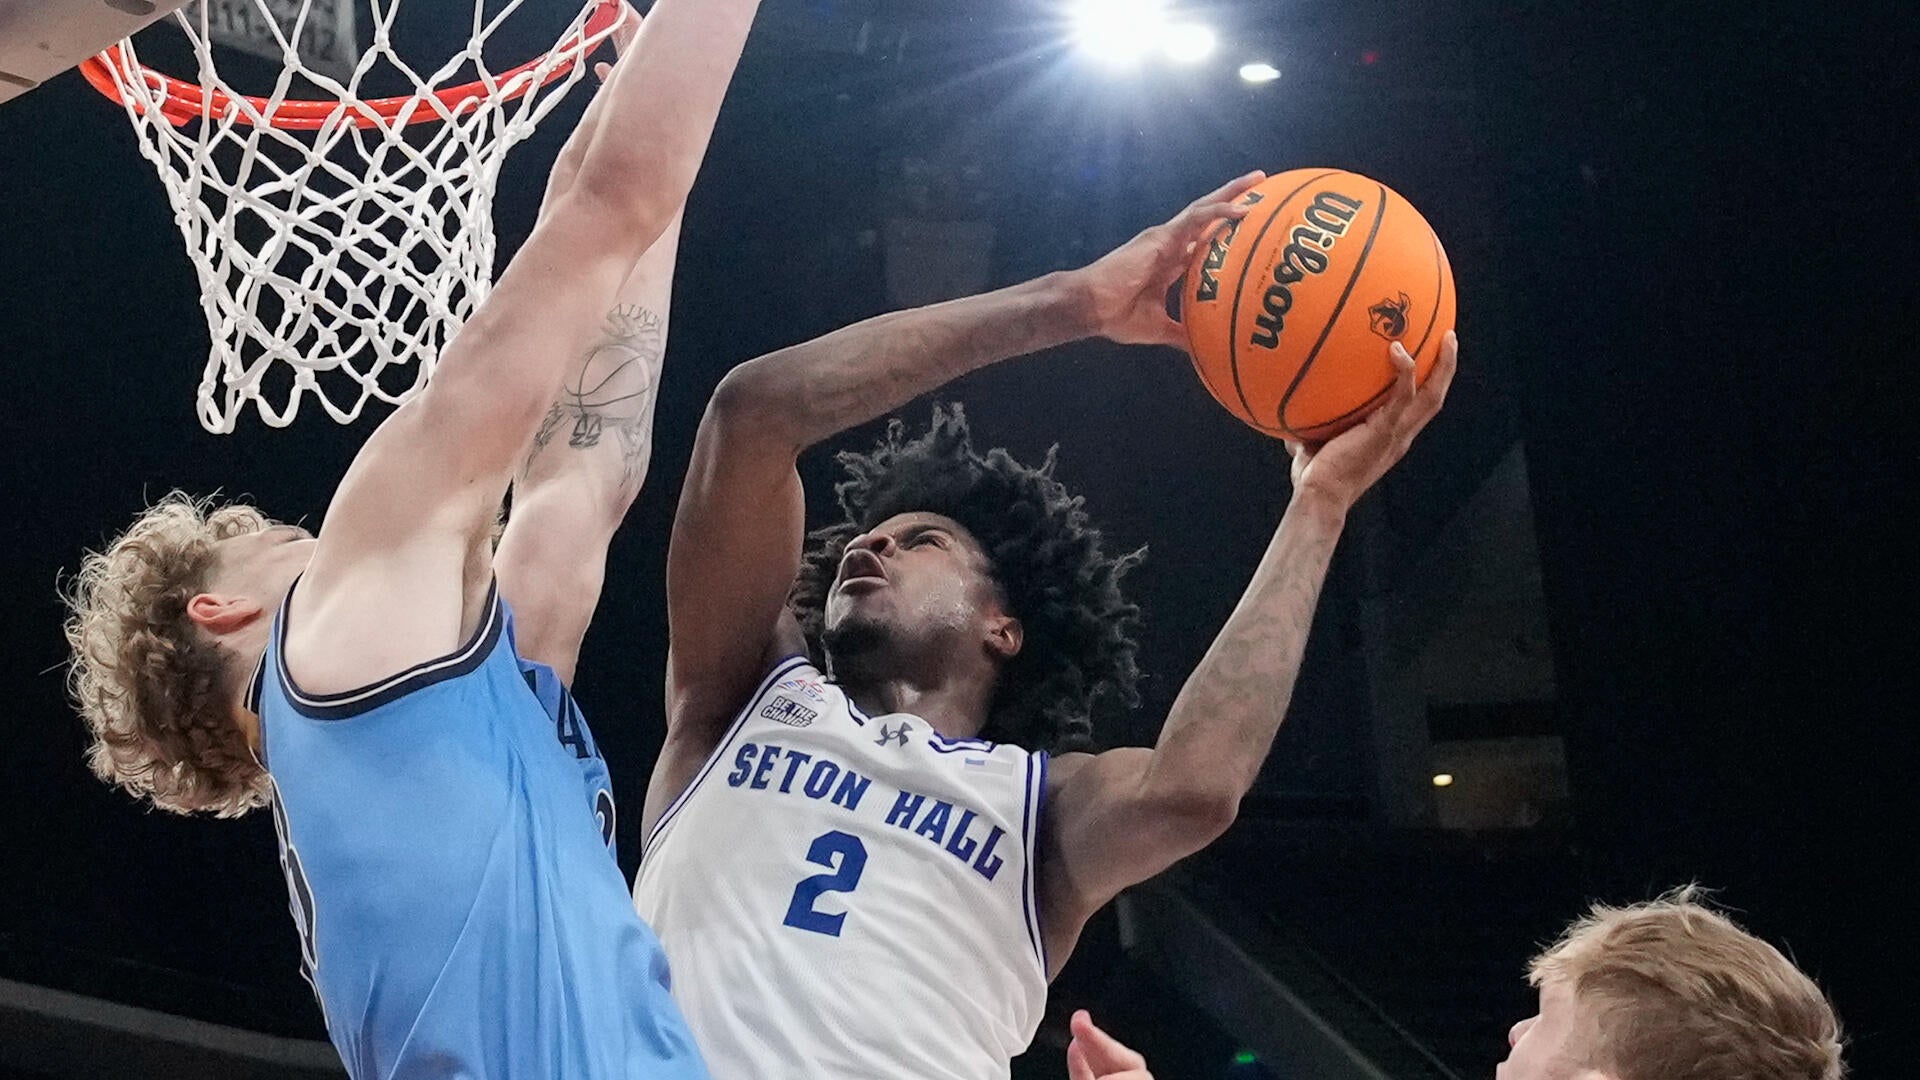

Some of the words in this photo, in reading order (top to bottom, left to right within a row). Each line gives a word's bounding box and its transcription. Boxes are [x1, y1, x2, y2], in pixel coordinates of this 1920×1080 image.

[1250, 190, 1365, 351] Wilson
[760, 705, 811, 727] CHANGE
[773, 695, 792, 712] BE
[791, 703, 817, 721] THE
[727, 742, 872, 811] SETON
[885, 789, 1007, 881] HALL
[783, 829, 869, 937] 2
